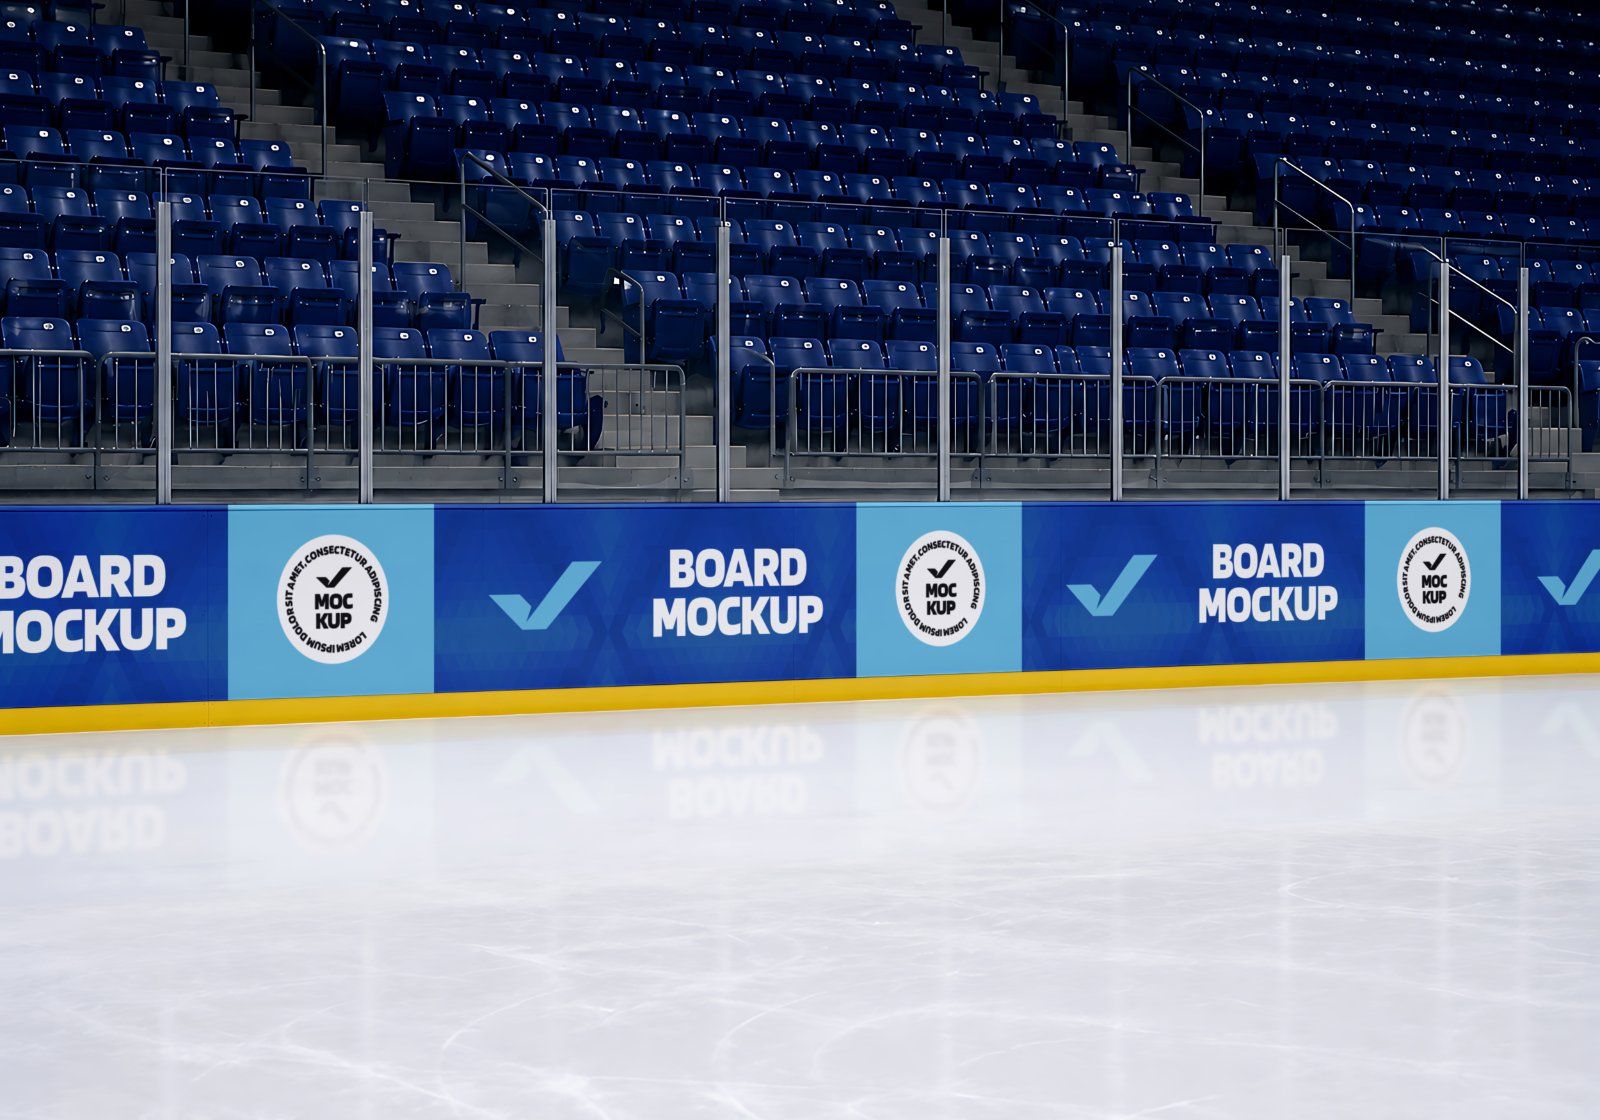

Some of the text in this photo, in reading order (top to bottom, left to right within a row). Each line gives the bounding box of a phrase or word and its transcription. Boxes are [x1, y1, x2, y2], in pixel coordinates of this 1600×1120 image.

[918, 540, 969, 560] CONSECTETUR
[1415, 536, 1457, 554] CONSECTETUR
[669, 548, 807, 588] BOARD
[904, 554, 920, 580] AMET,
[1212, 543, 1324, 579] BOARD
[0, 555, 166, 599] BOARD
[966, 558, 980, 609] ADIPISCING
[1422, 575, 1448, 588] MOC
[1455, 552, 1466, 599] ADIPISCING
[285, 545, 382, 653] LOREM IPSUM DOLOR SIT AMET, CONSECTETUR ADIPISCING
[926, 583, 957, 598] MOC
[1403, 587, 1417, 614] DOLOR
[1422, 590, 1446, 604] KUP
[314, 593, 354, 610] MOC
[903, 596, 921, 626] DOLOR
[926, 600, 956, 615] KUP
[1199, 586, 1338, 623] MOCKUP
[316, 612, 352, 630] KUP
[652, 596, 824, 637] MOCKUP
[1416, 610, 1436, 623] IPSUM
[1436, 606, 1457, 623] LOREM
[919, 622, 942, 636] IPSUM
[943, 617, 968, 636] LOREM
